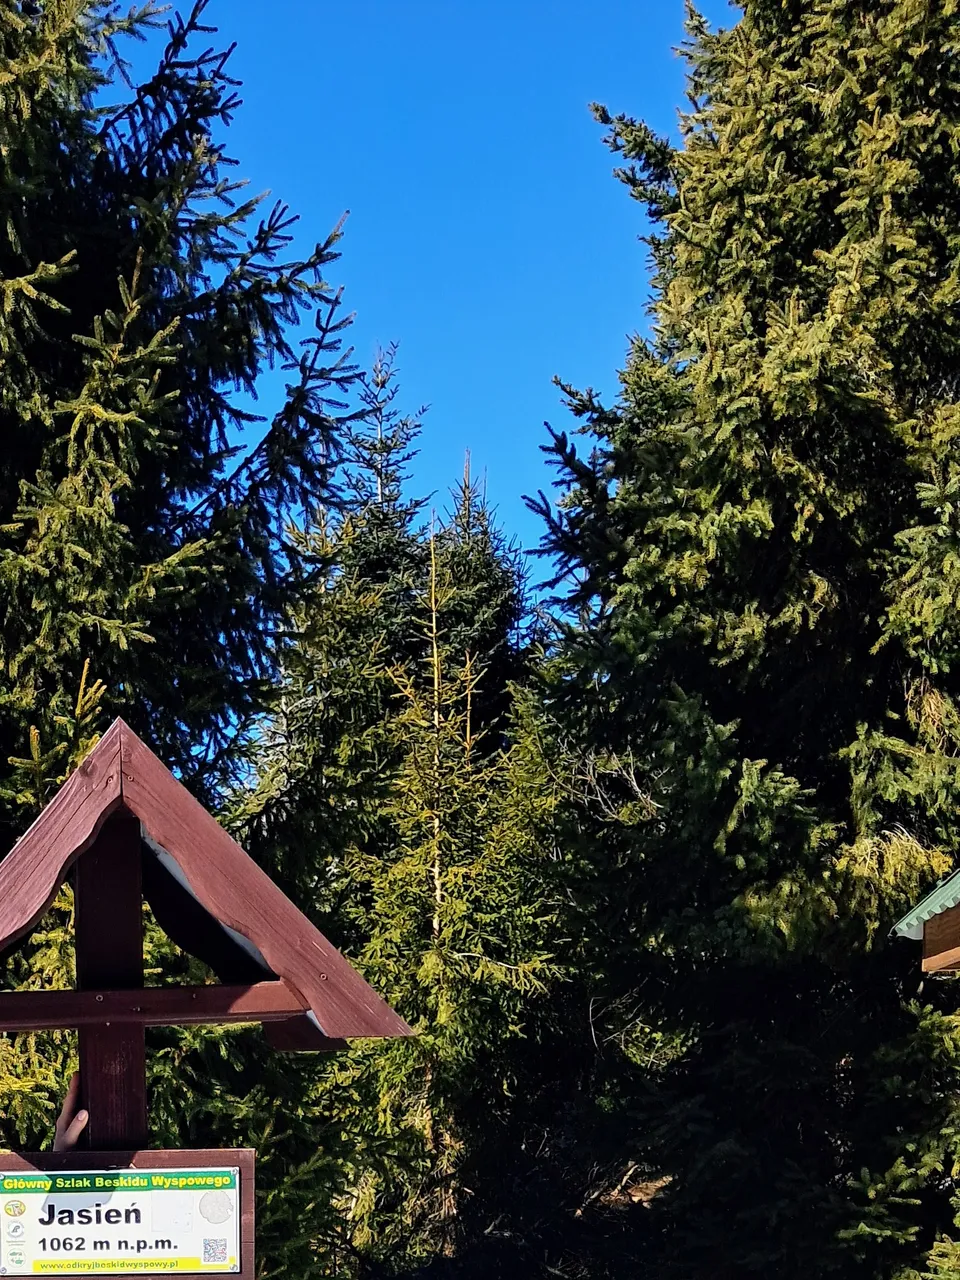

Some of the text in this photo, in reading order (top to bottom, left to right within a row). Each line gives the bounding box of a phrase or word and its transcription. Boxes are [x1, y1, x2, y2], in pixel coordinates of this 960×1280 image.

[3, 1175, 231, 1190] Główny Szlak Beskidu Wyspowego
[38, 1202, 141, 1226] Jasień
[38, 1237, 86, 1251] 1062
[93, 1239, 110, 1251] m
[118, 1238, 179, 1253] n.p.m.
[40, 1259, 179, 1270] www.odkryjbeskidwyspowy.pl
